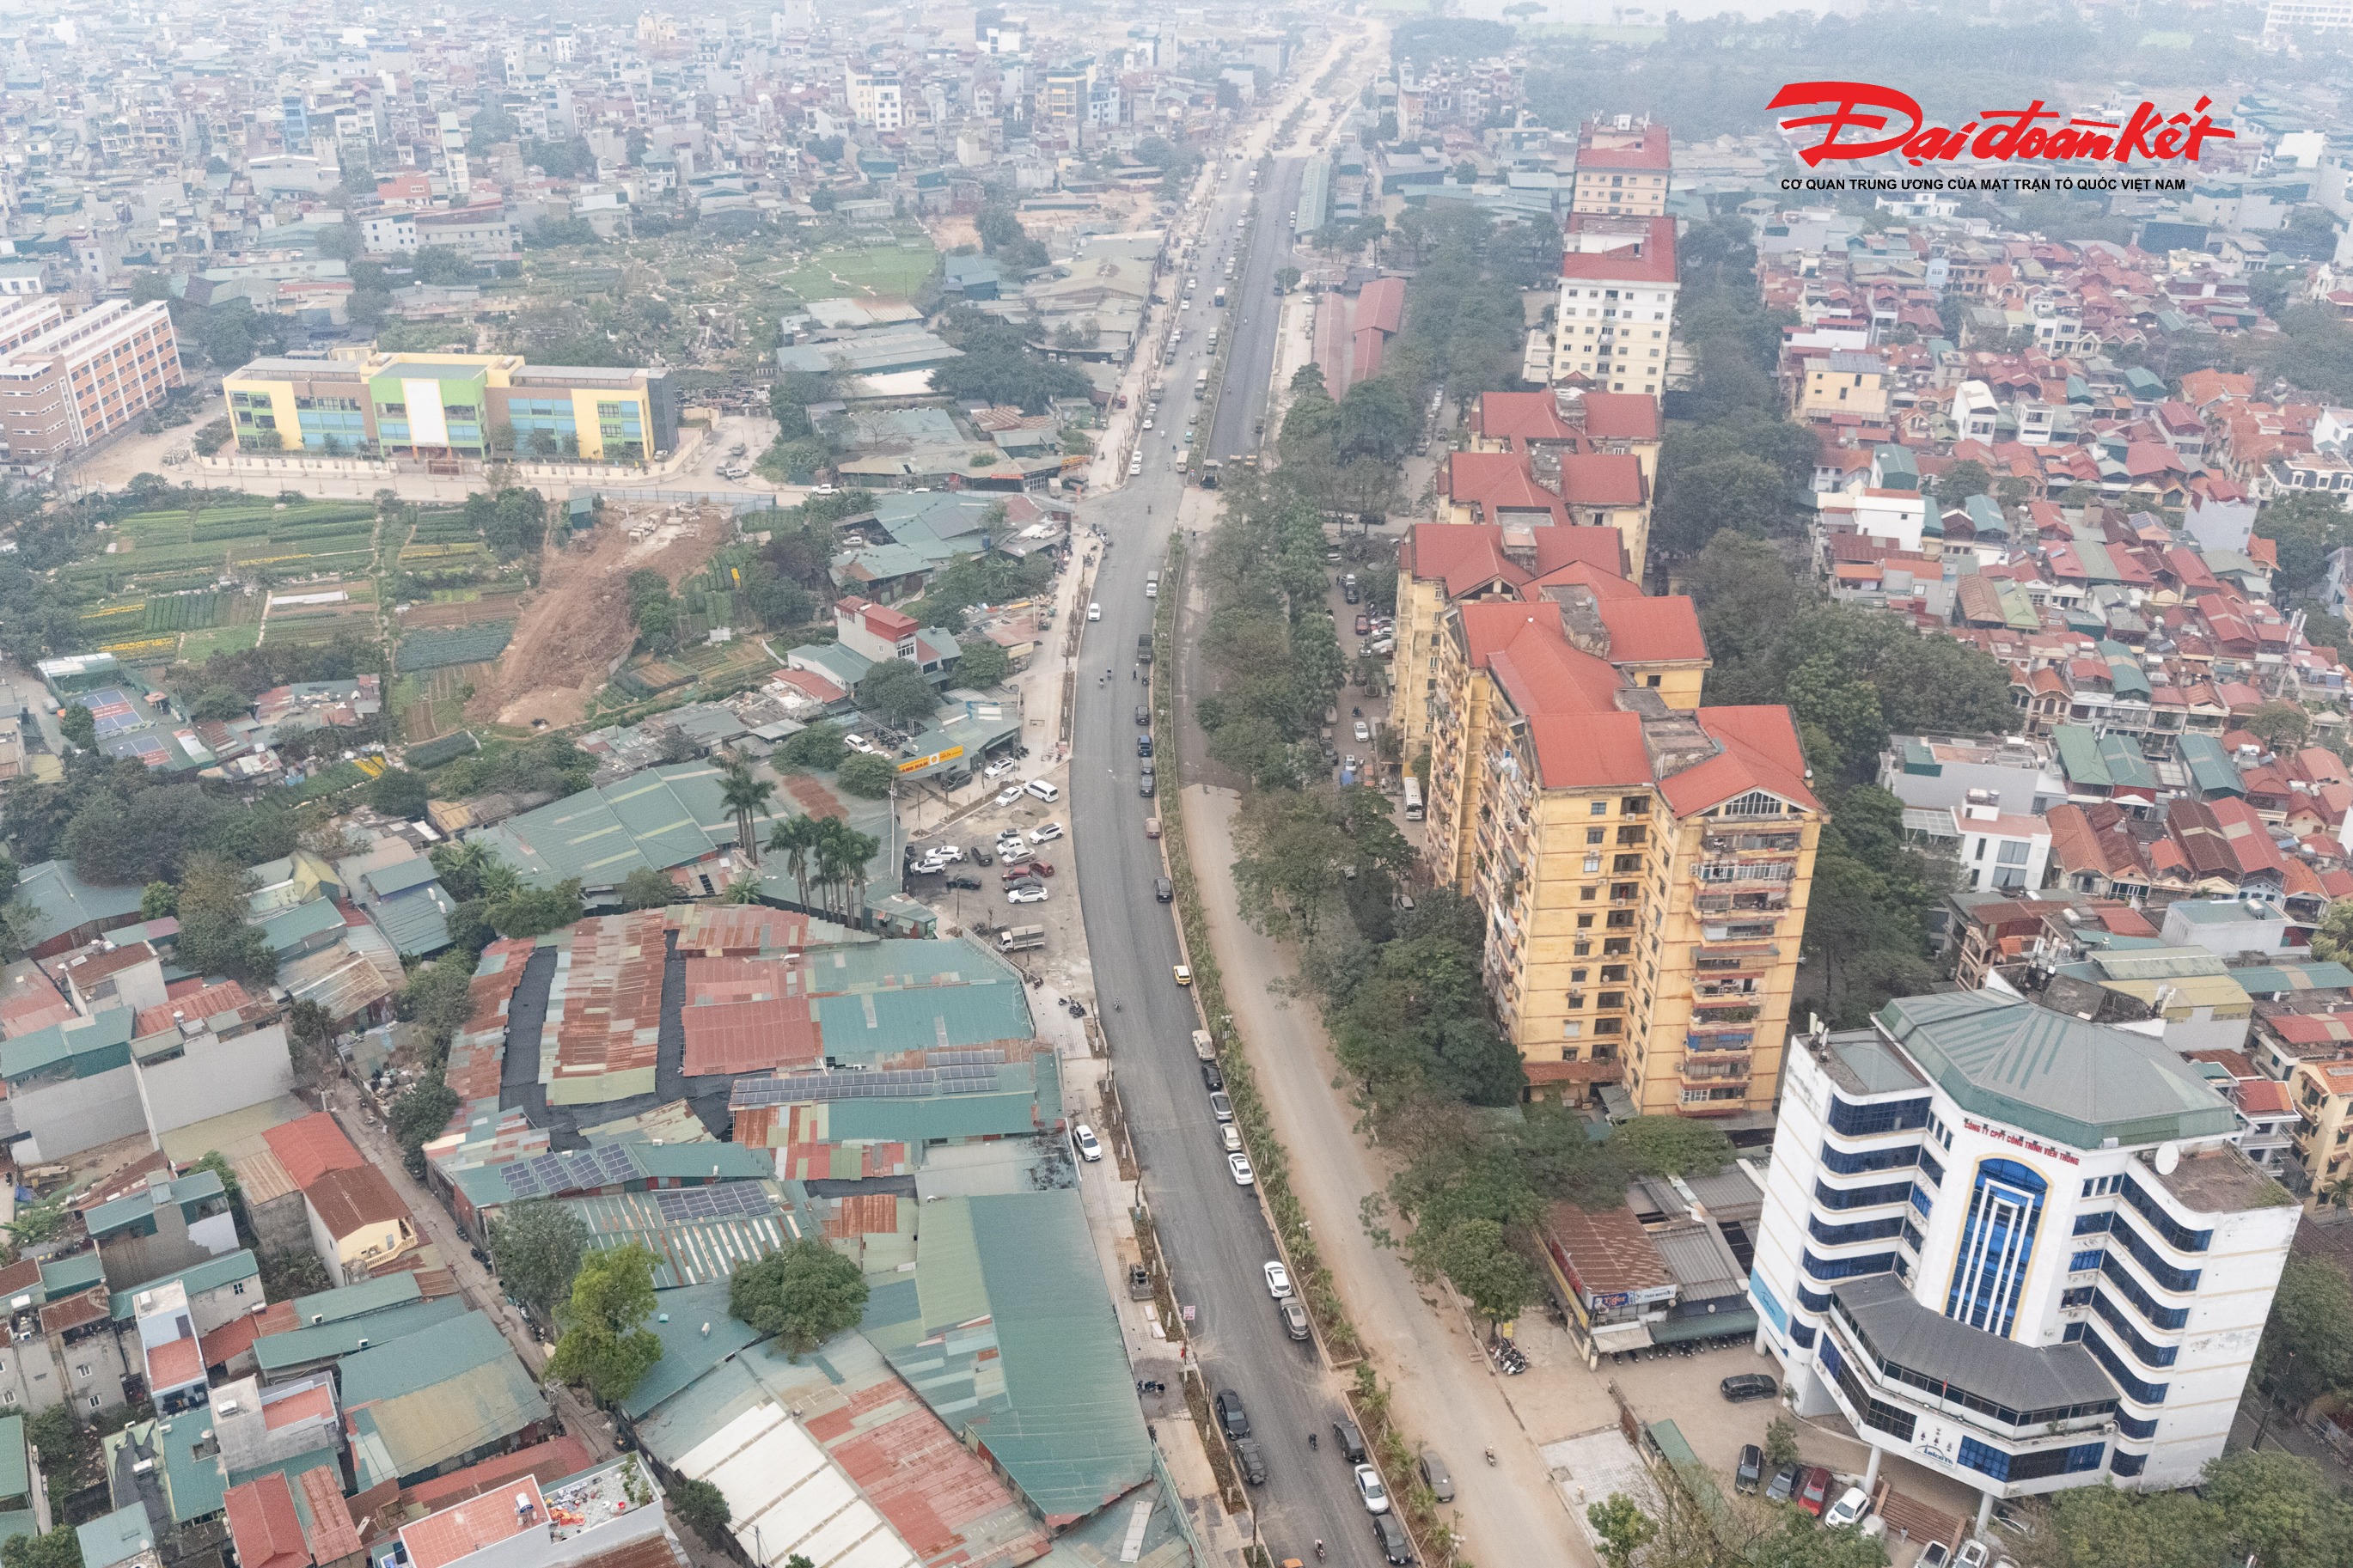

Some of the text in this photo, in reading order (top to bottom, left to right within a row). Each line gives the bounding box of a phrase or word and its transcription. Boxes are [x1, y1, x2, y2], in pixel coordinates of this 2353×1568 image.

[1964, 1121, 1981, 1132] CÔNG
[2007, 1136, 2023, 1147] CÔNG
[2059, 1152, 2080, 1166] THÔNG
